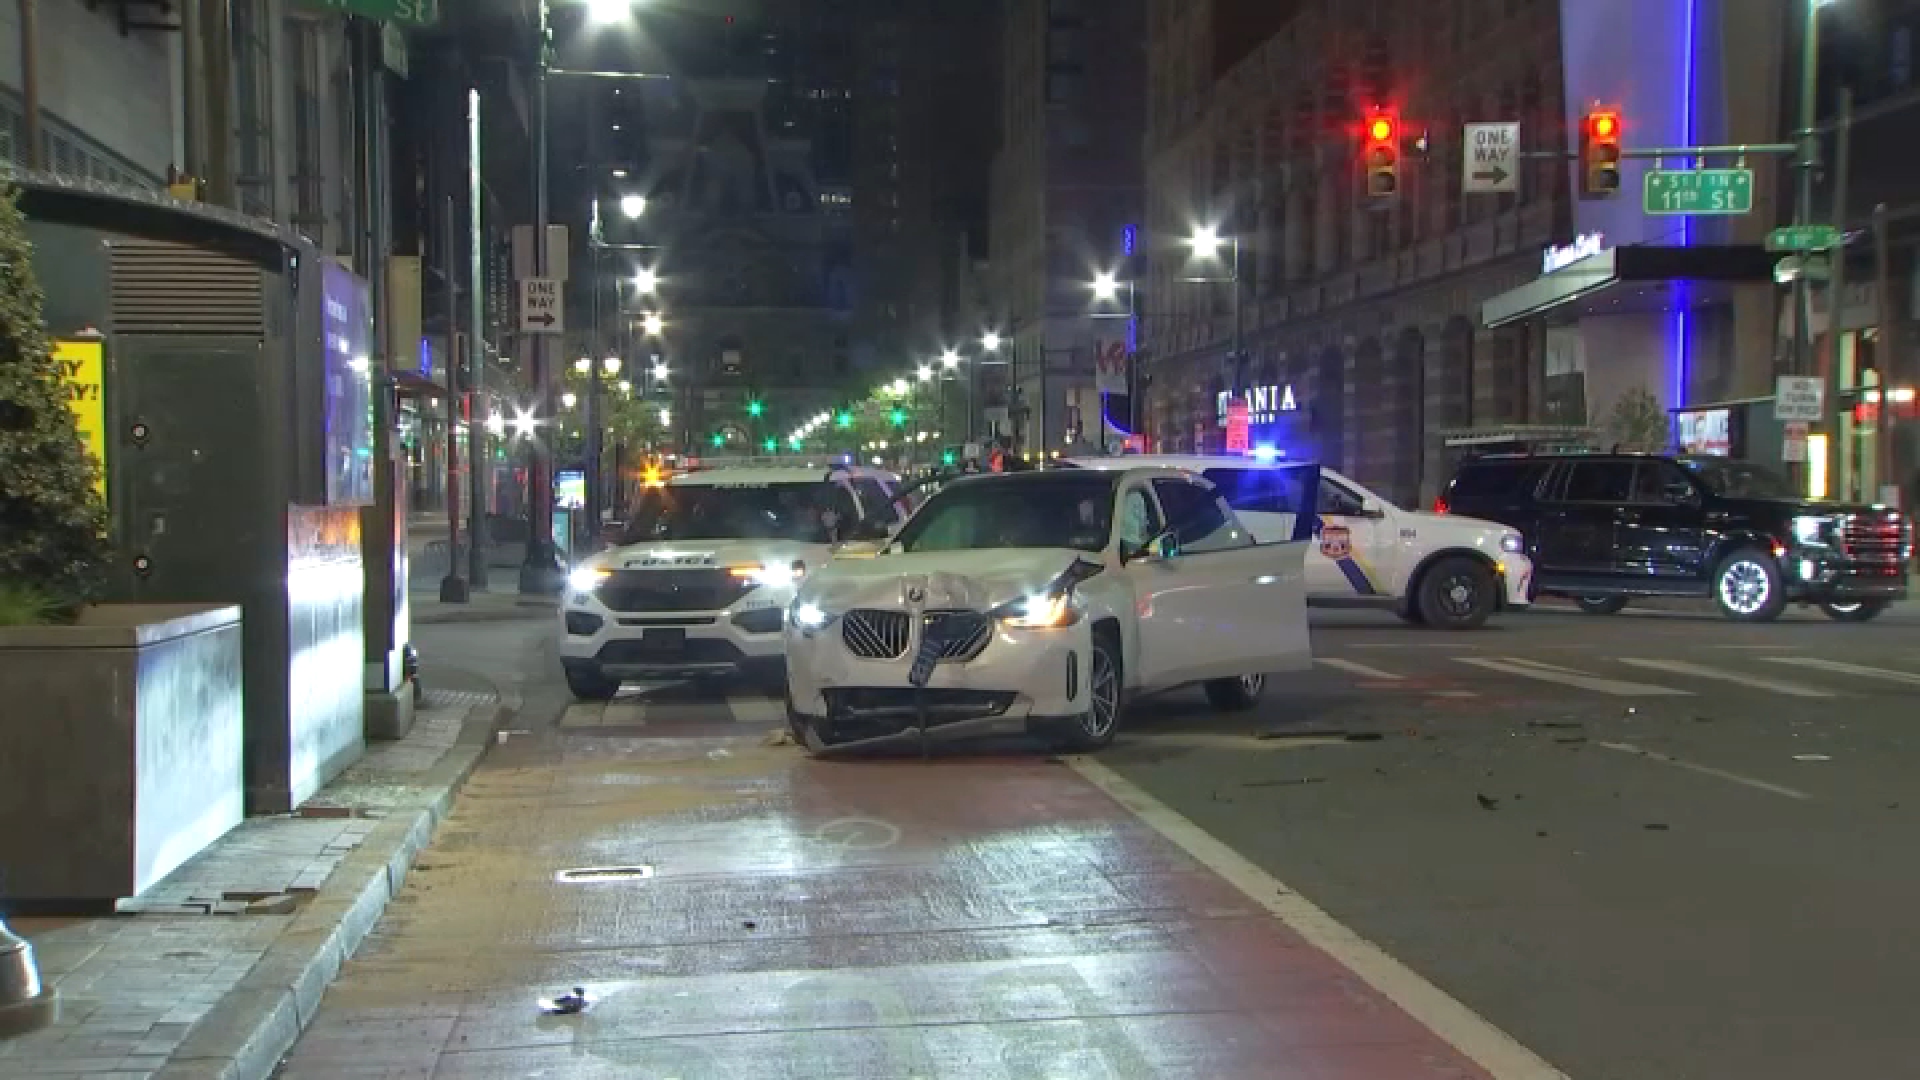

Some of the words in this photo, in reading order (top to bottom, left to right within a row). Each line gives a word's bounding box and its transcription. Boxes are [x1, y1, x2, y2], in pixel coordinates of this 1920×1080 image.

[1475, 129, 1509, 145] ONE
[1474, 147, 1510, 162] WAY
[1711, 190, 1736, 209] St
[527, 282, 556, 294] ONE
[527, 296, 556, 309] WAY
